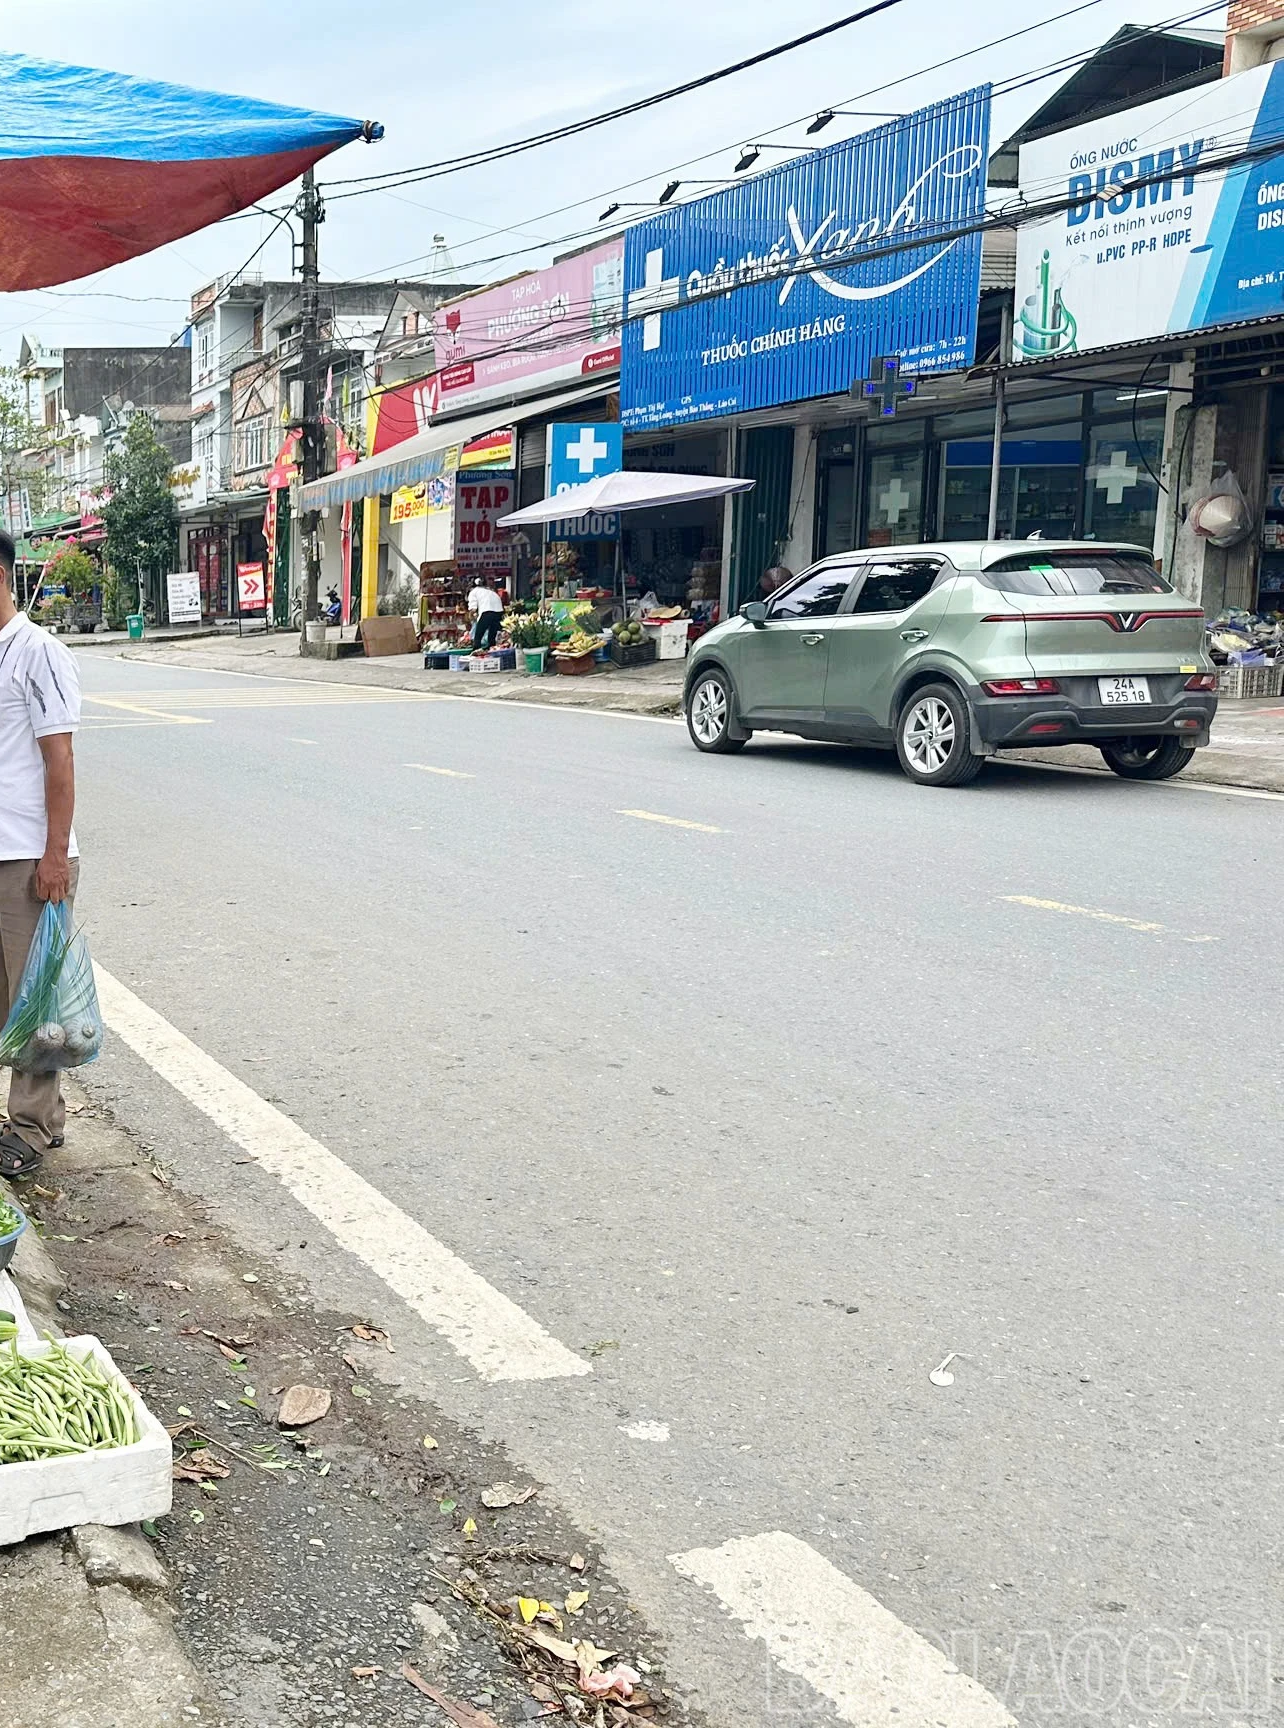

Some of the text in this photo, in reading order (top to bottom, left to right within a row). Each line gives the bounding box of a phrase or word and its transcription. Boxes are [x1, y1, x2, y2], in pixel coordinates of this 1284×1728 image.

[1069, 136, 1138, 170] ỐNG NƯỚC
[1066, 137, 1205, 227] DISMY
[686, 145, 983, 306] Quầy thuốc Xanh
[1066, 205, 1193, 246] Kết nối thịnh vượng
[1257, 208, 1284, 231] DIS
[1131, 237, 1157, 256] PP-R
[1163, 228, 1192, 248] HDPE
[702, 314, 846, 366] THUỐC CHÍNH HÃNG
[938, 339, 947, 350] 7h
[953, 335, 966, 347] 22h
[919, 356, 935, 368] 0966
[1107, 690, 1146, 703] 525.18
[1113, 678, 1135, 690] 24A
